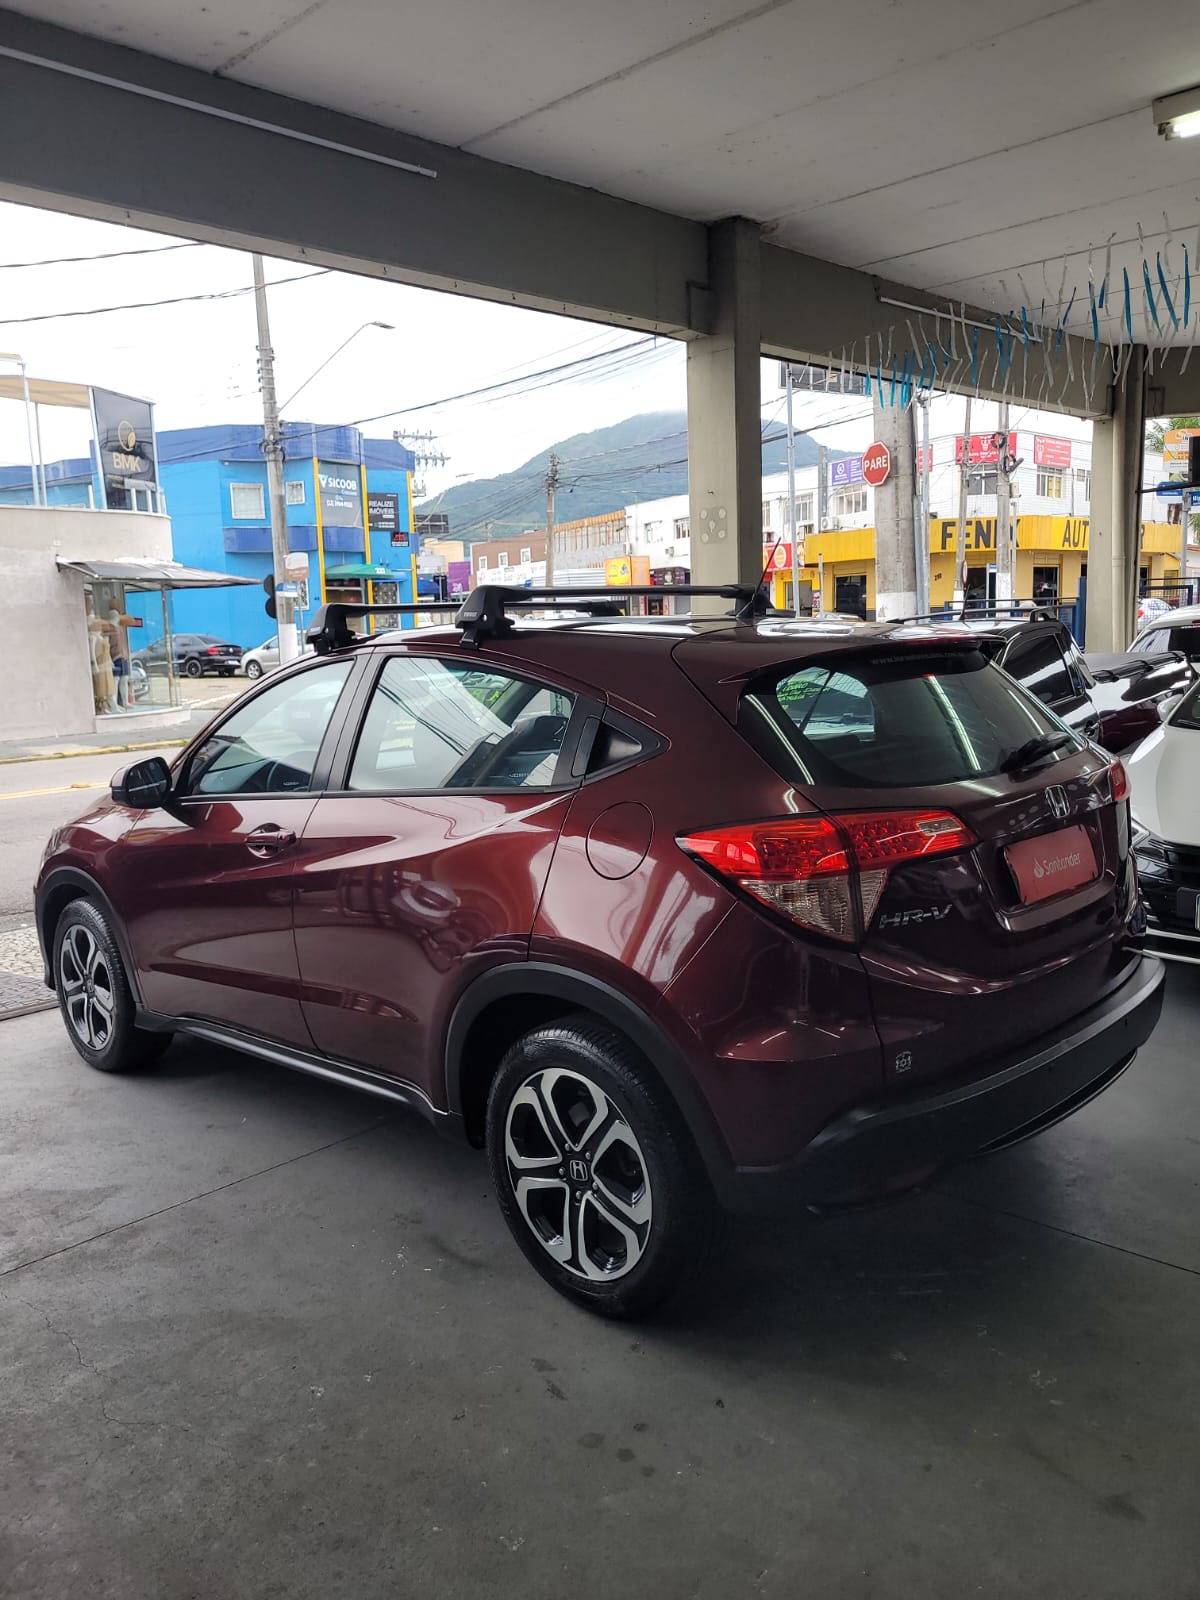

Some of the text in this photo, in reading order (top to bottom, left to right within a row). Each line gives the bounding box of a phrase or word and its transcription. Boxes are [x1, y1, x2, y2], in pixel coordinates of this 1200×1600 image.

[112, 451, 141, 472] BMK
[864, 455, 888, 472] PARE
[328, 477, 357, 490] SICOOB
[368, 500, 395, 508] REALIZE
[1043, 852, 1081, 875] Santander
[879, 904, 953, 928] HR-V
